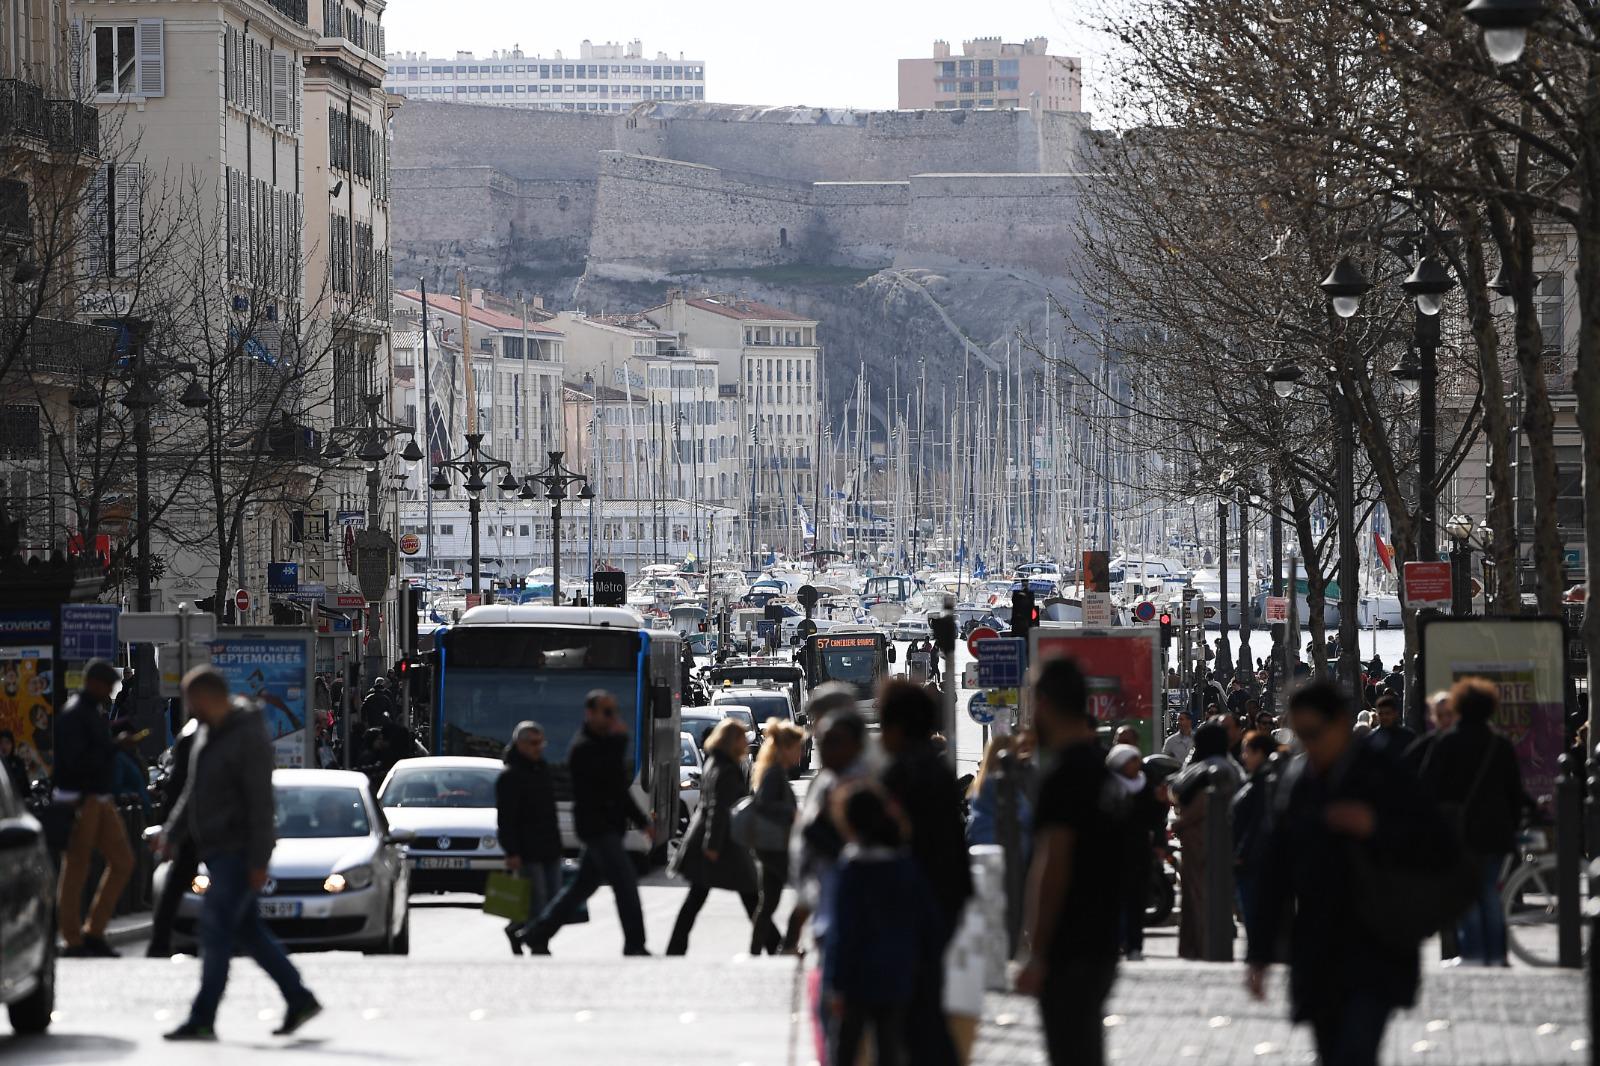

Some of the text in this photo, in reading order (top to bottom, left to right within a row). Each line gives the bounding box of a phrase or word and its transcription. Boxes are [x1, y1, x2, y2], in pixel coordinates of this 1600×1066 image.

[403, 541, 418, 549] KING
[817, 639, 829, 648] 57
[226, 645, 266, 653] COURSES
[268, 645, 301, 653] NATURE
[211, 653, 301, 664] SEPTEMOISES
